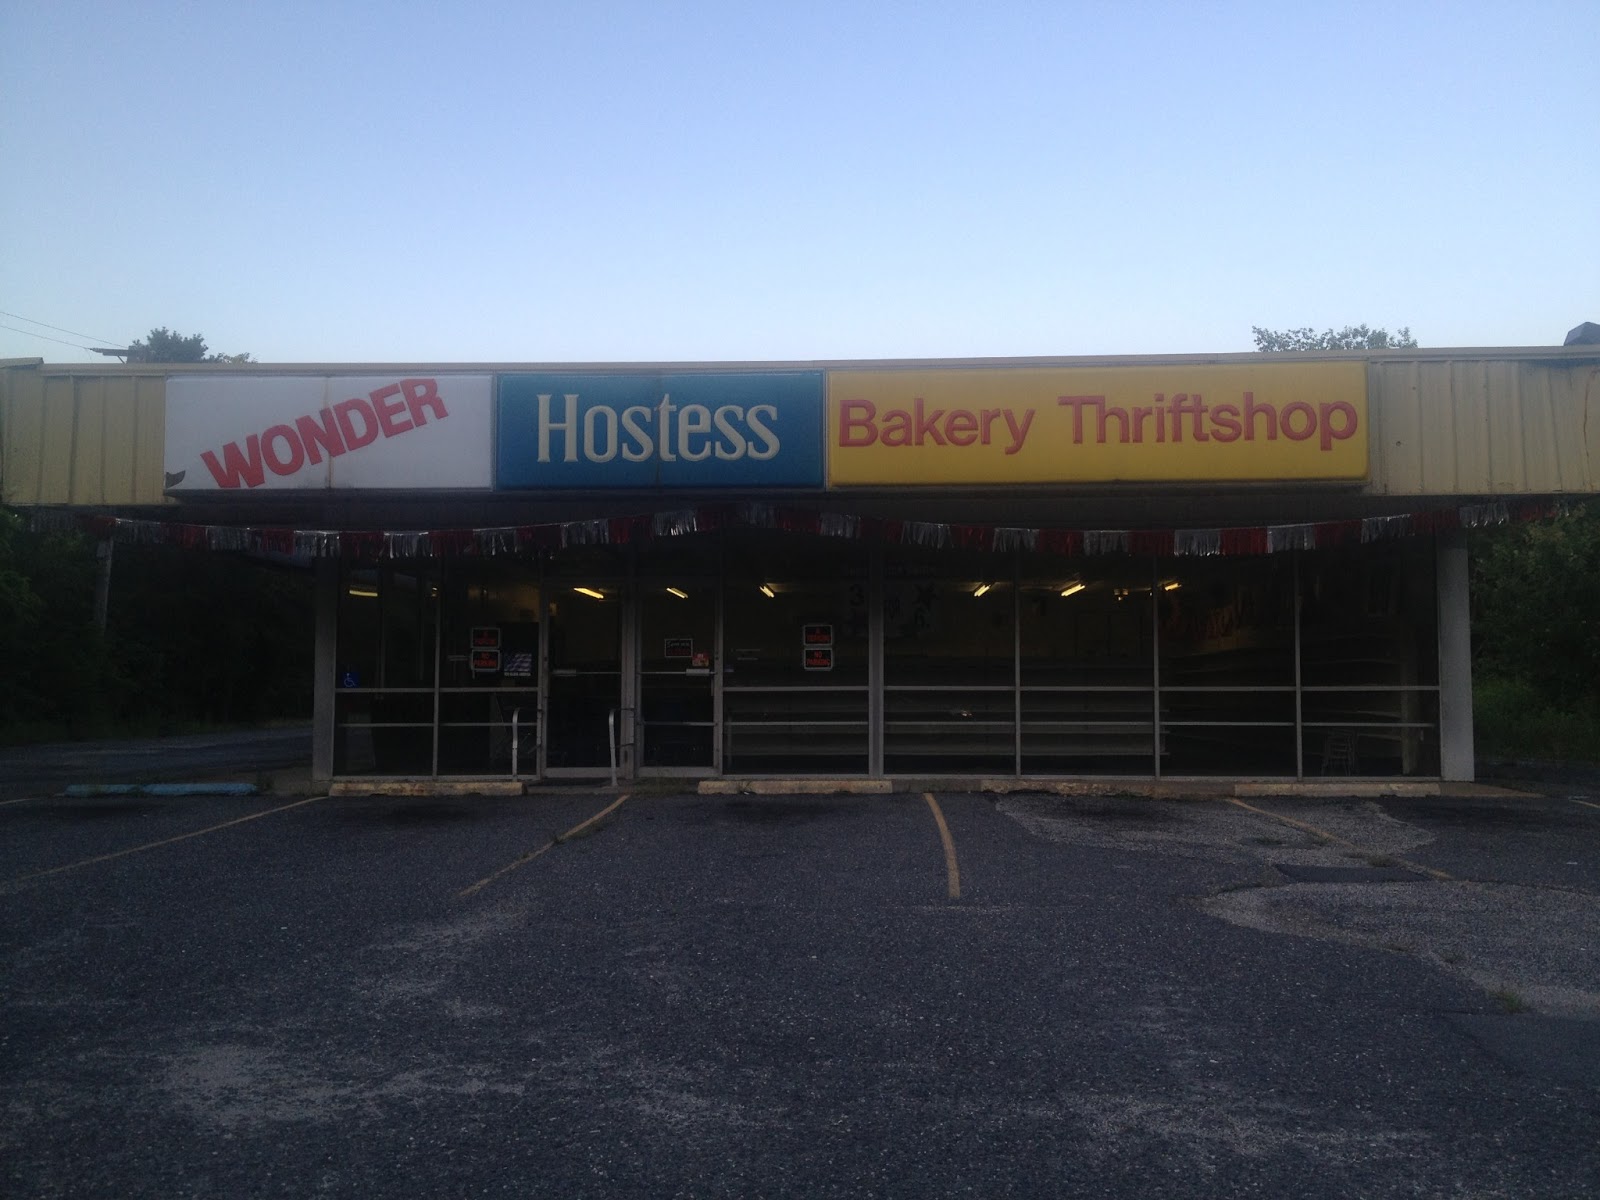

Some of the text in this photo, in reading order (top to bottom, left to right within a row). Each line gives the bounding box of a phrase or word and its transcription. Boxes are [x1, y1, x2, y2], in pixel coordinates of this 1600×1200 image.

[200, 378, 448, 489] WONDER
[536, 393, 781, 464] Hostess
[839, 391, 1358, 455] Bakery Thriftshop
